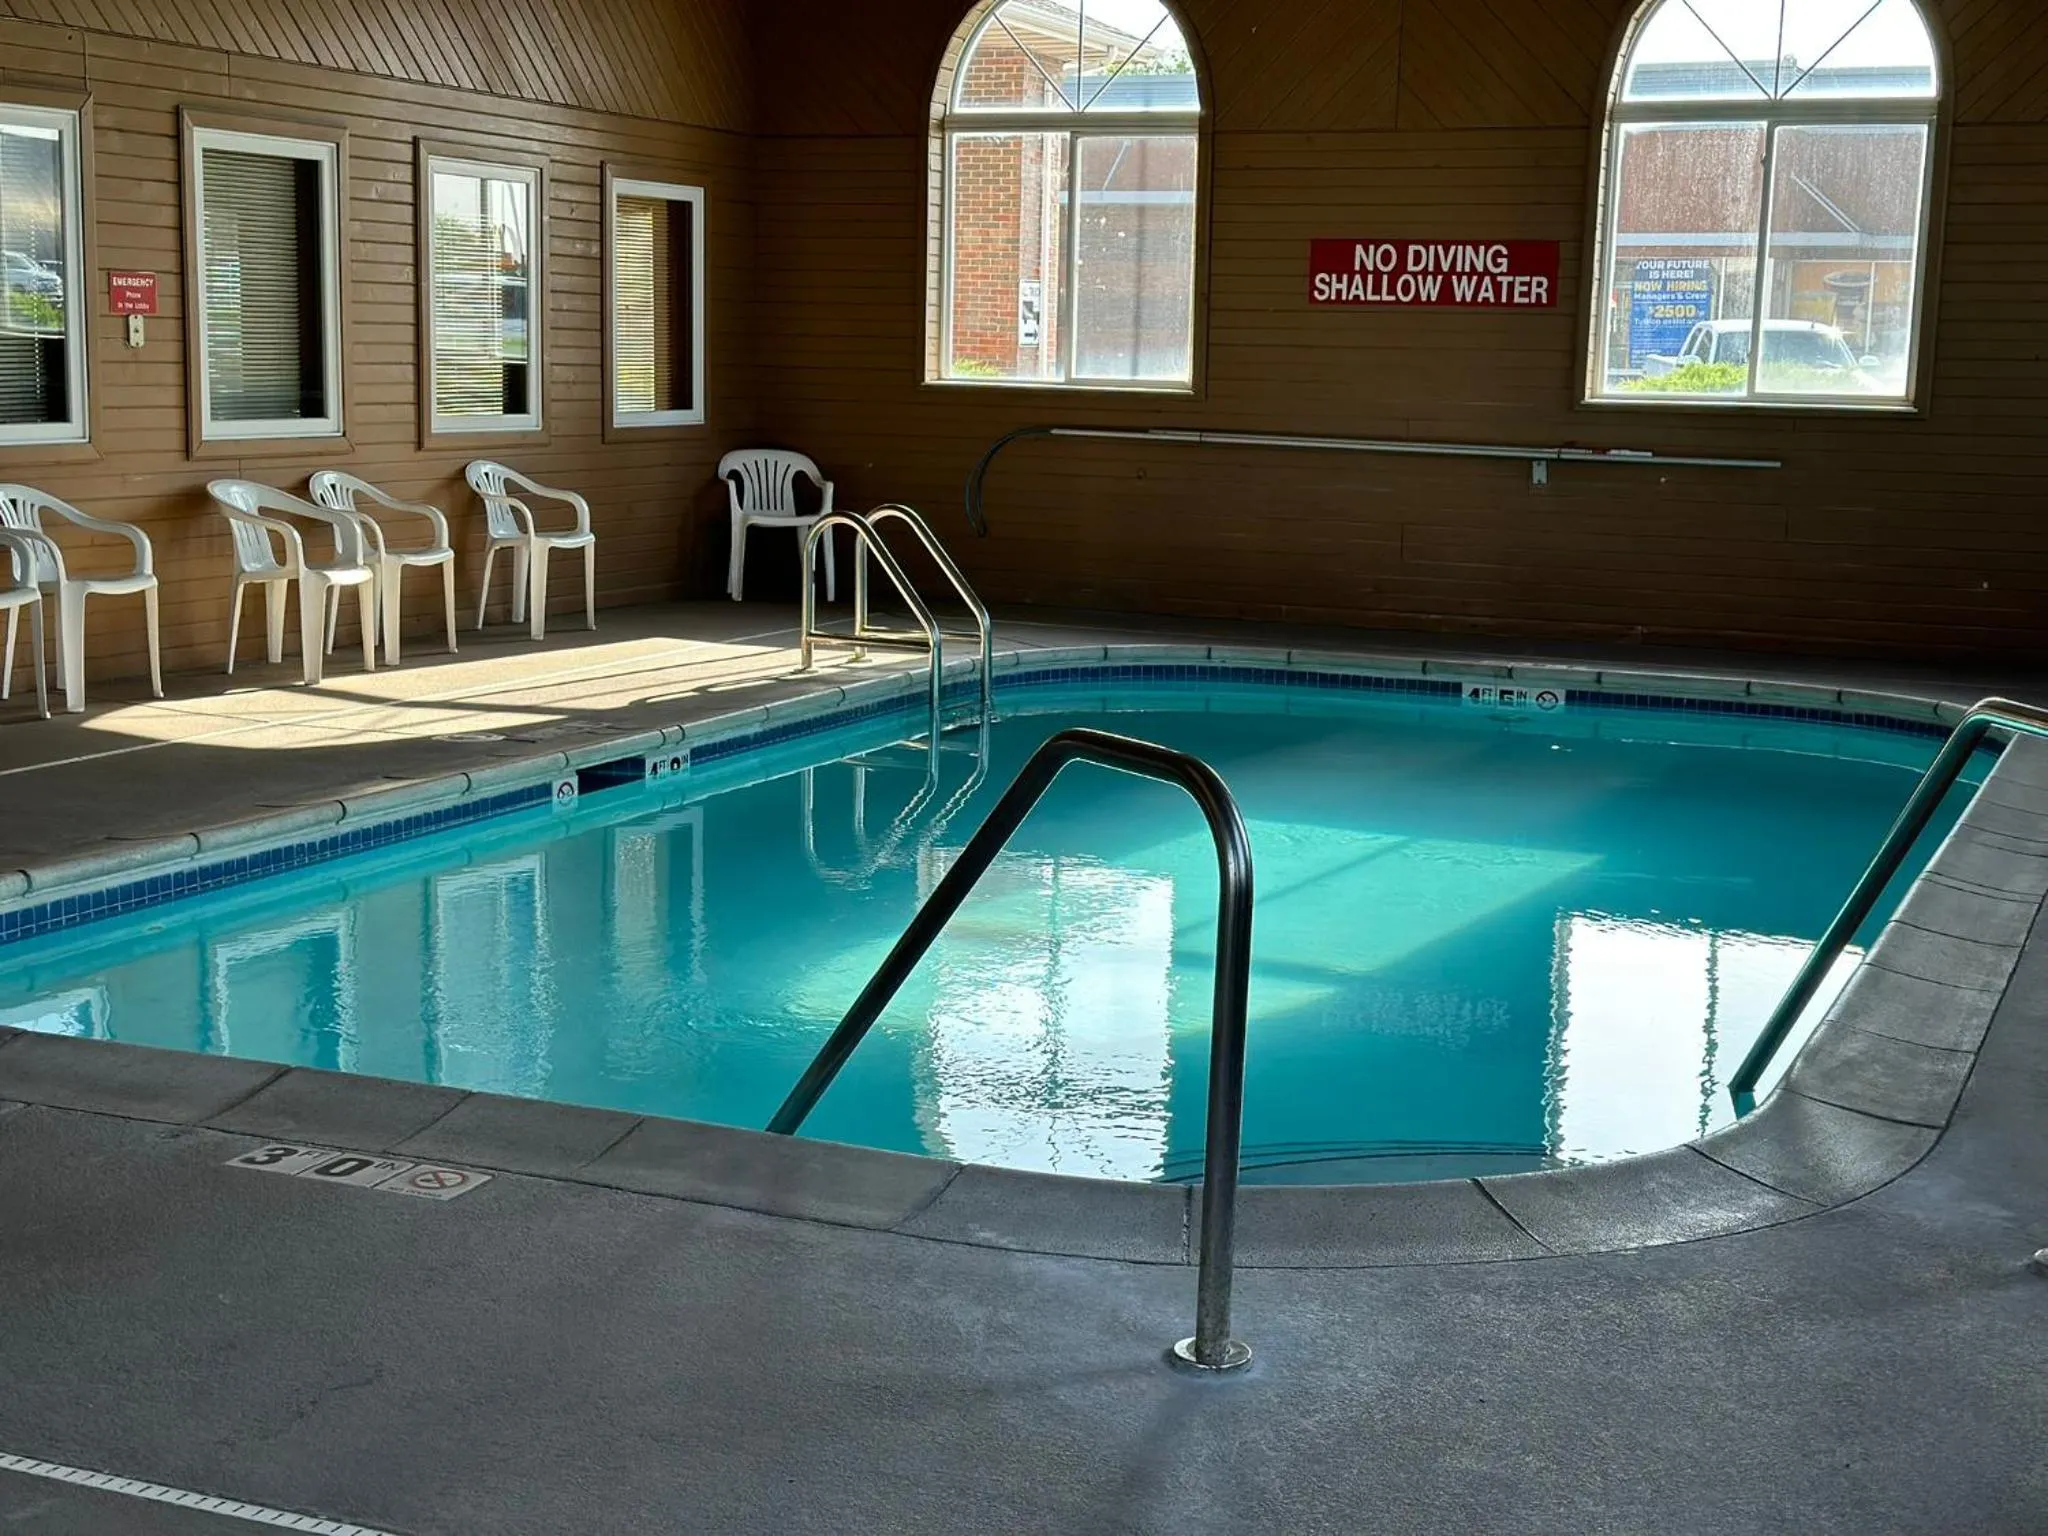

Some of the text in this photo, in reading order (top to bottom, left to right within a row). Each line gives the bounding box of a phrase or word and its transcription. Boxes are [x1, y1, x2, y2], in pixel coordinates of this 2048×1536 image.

[1353, 244, 1509, 274] NO DIVING
[1666, 260, 1709, 270] FUTURE
[1648, 270, 1660, 279] IS
[112, 276, 154, 287] EMERGENCY
[1313, 272, 1549, 304] SHALLOW WATER
[1633, 281, 1708, 292] NOW HIRING
[1468, 687, 1480, 699] 4
[1516, 690, 1528, 700] IN
[650, 761, 658, 776] 4
[659, 760, 668, 769] FT
[670, 757, 681, 771] 0
[240, 1147, 400, 1178] 3 FT 0 IN
